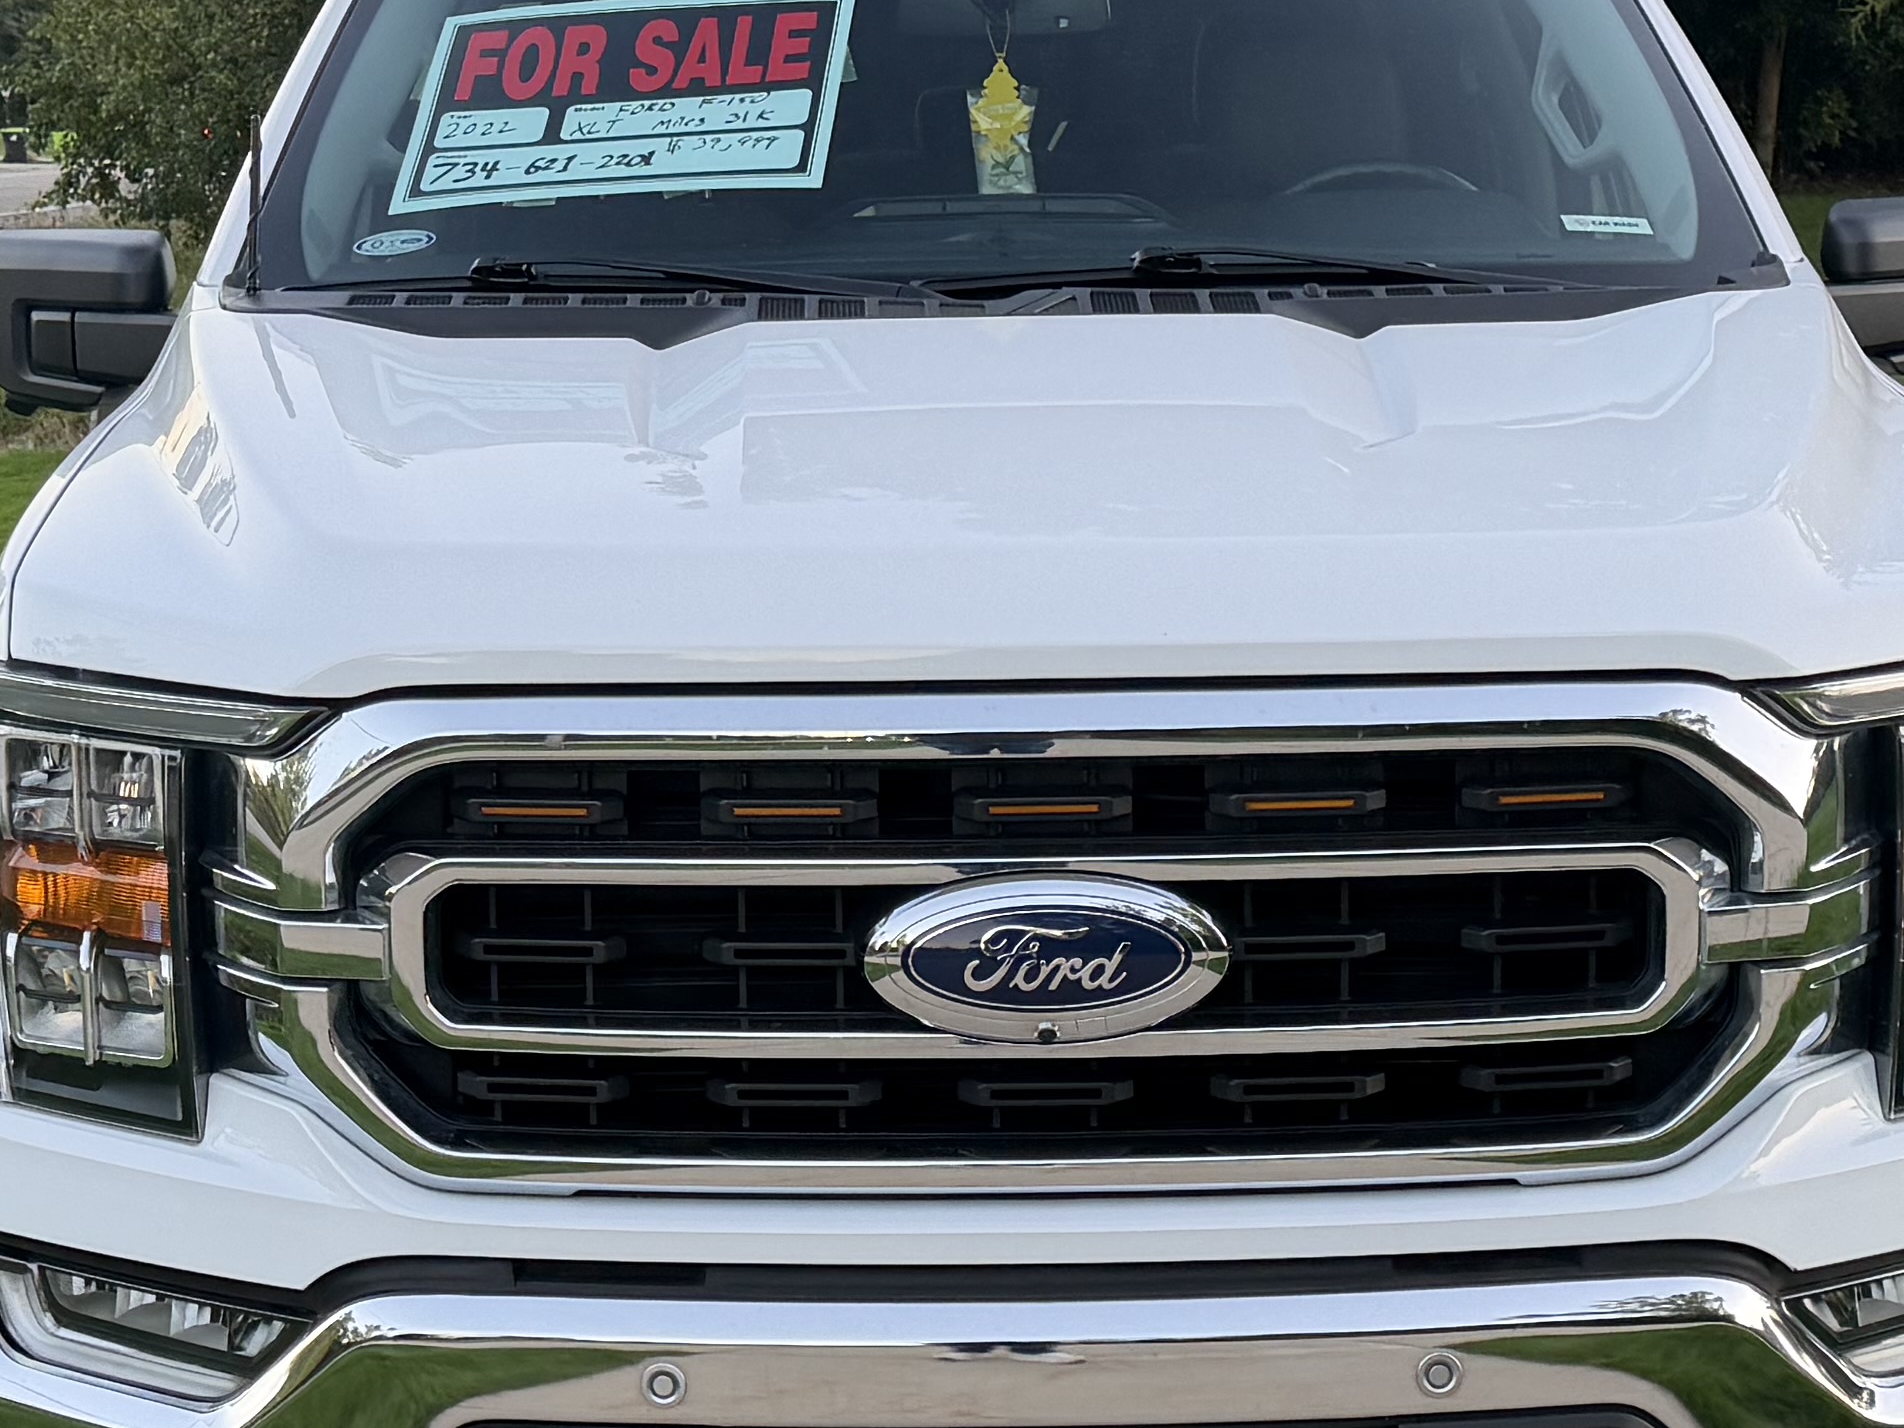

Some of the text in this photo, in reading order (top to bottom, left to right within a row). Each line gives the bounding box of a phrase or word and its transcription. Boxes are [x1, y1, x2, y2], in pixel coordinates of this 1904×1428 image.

[454, 12, 818, 100] FOR SALE
[615, 101, 676, 118] FORD
[442, 121, 517, 139] 2022
[569, 118, 624, 136] XLT
[963, 924, 1132, 992] Ford
